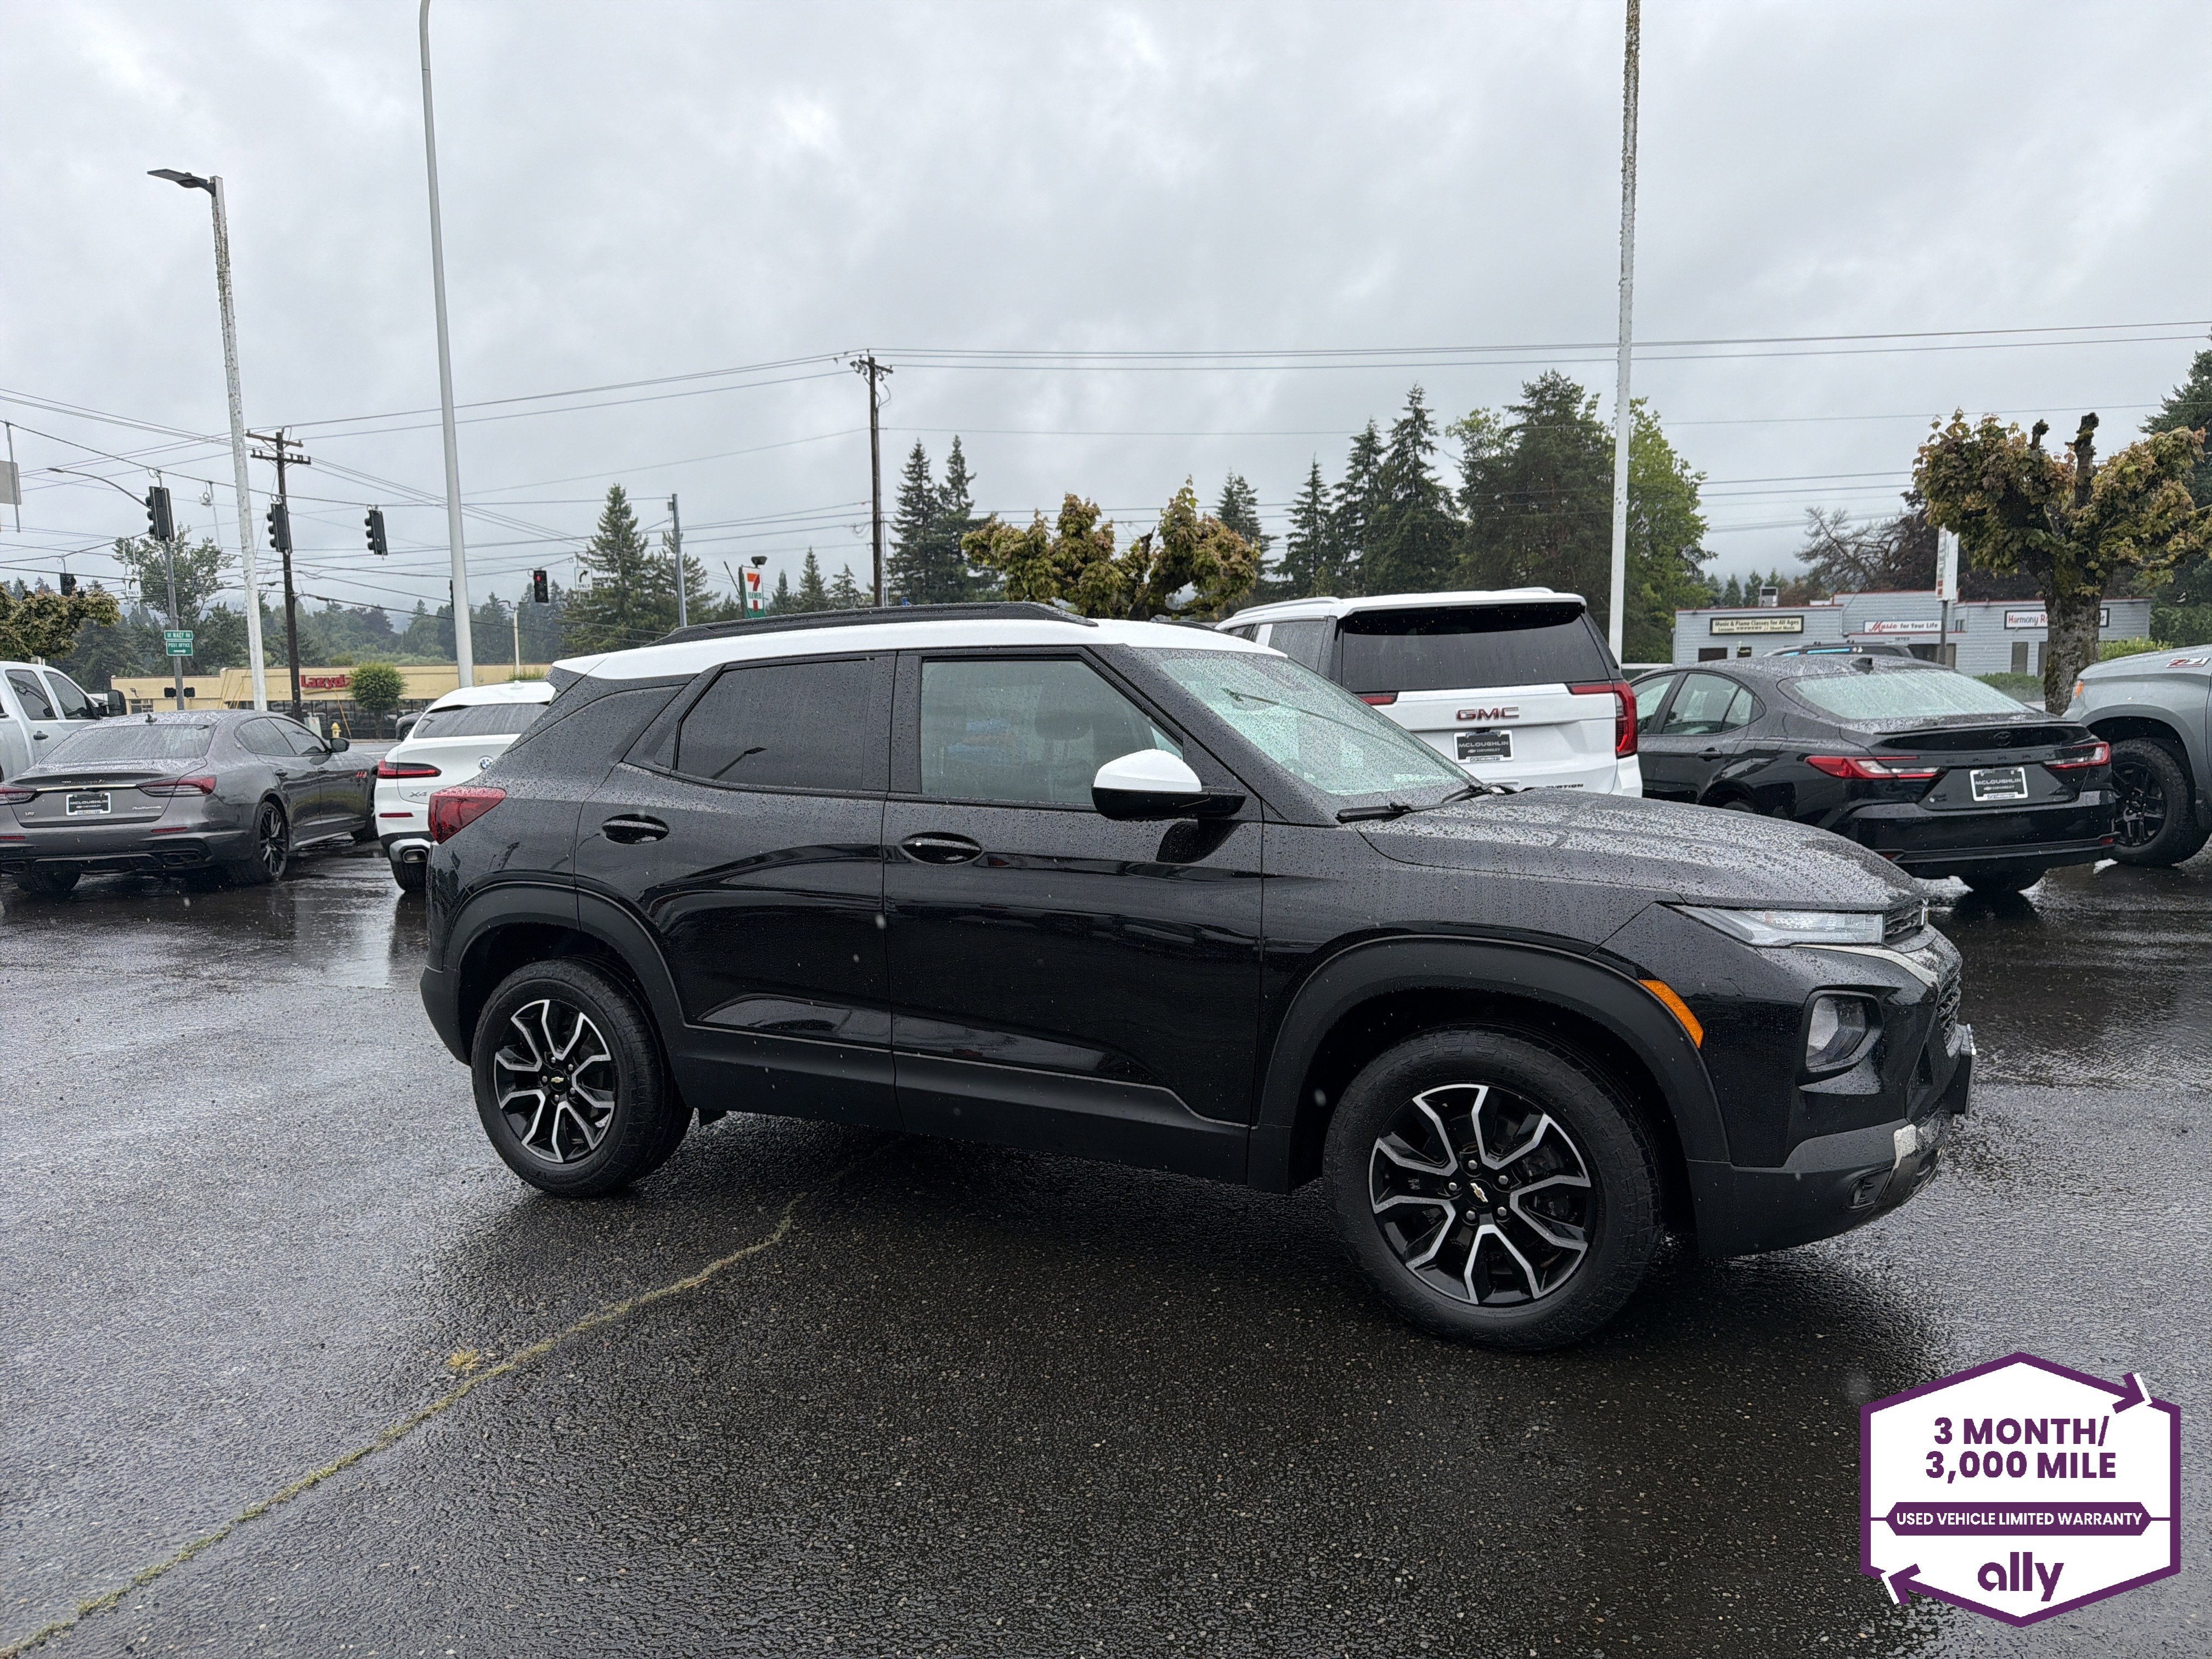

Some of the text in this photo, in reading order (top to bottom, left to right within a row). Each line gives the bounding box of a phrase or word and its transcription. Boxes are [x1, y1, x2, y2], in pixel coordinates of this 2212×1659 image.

[2008, 614, 2039, 625] Harmony
[1869, 620, 1898, 633] Music
[1457, 707, 1519, 721] GMC
